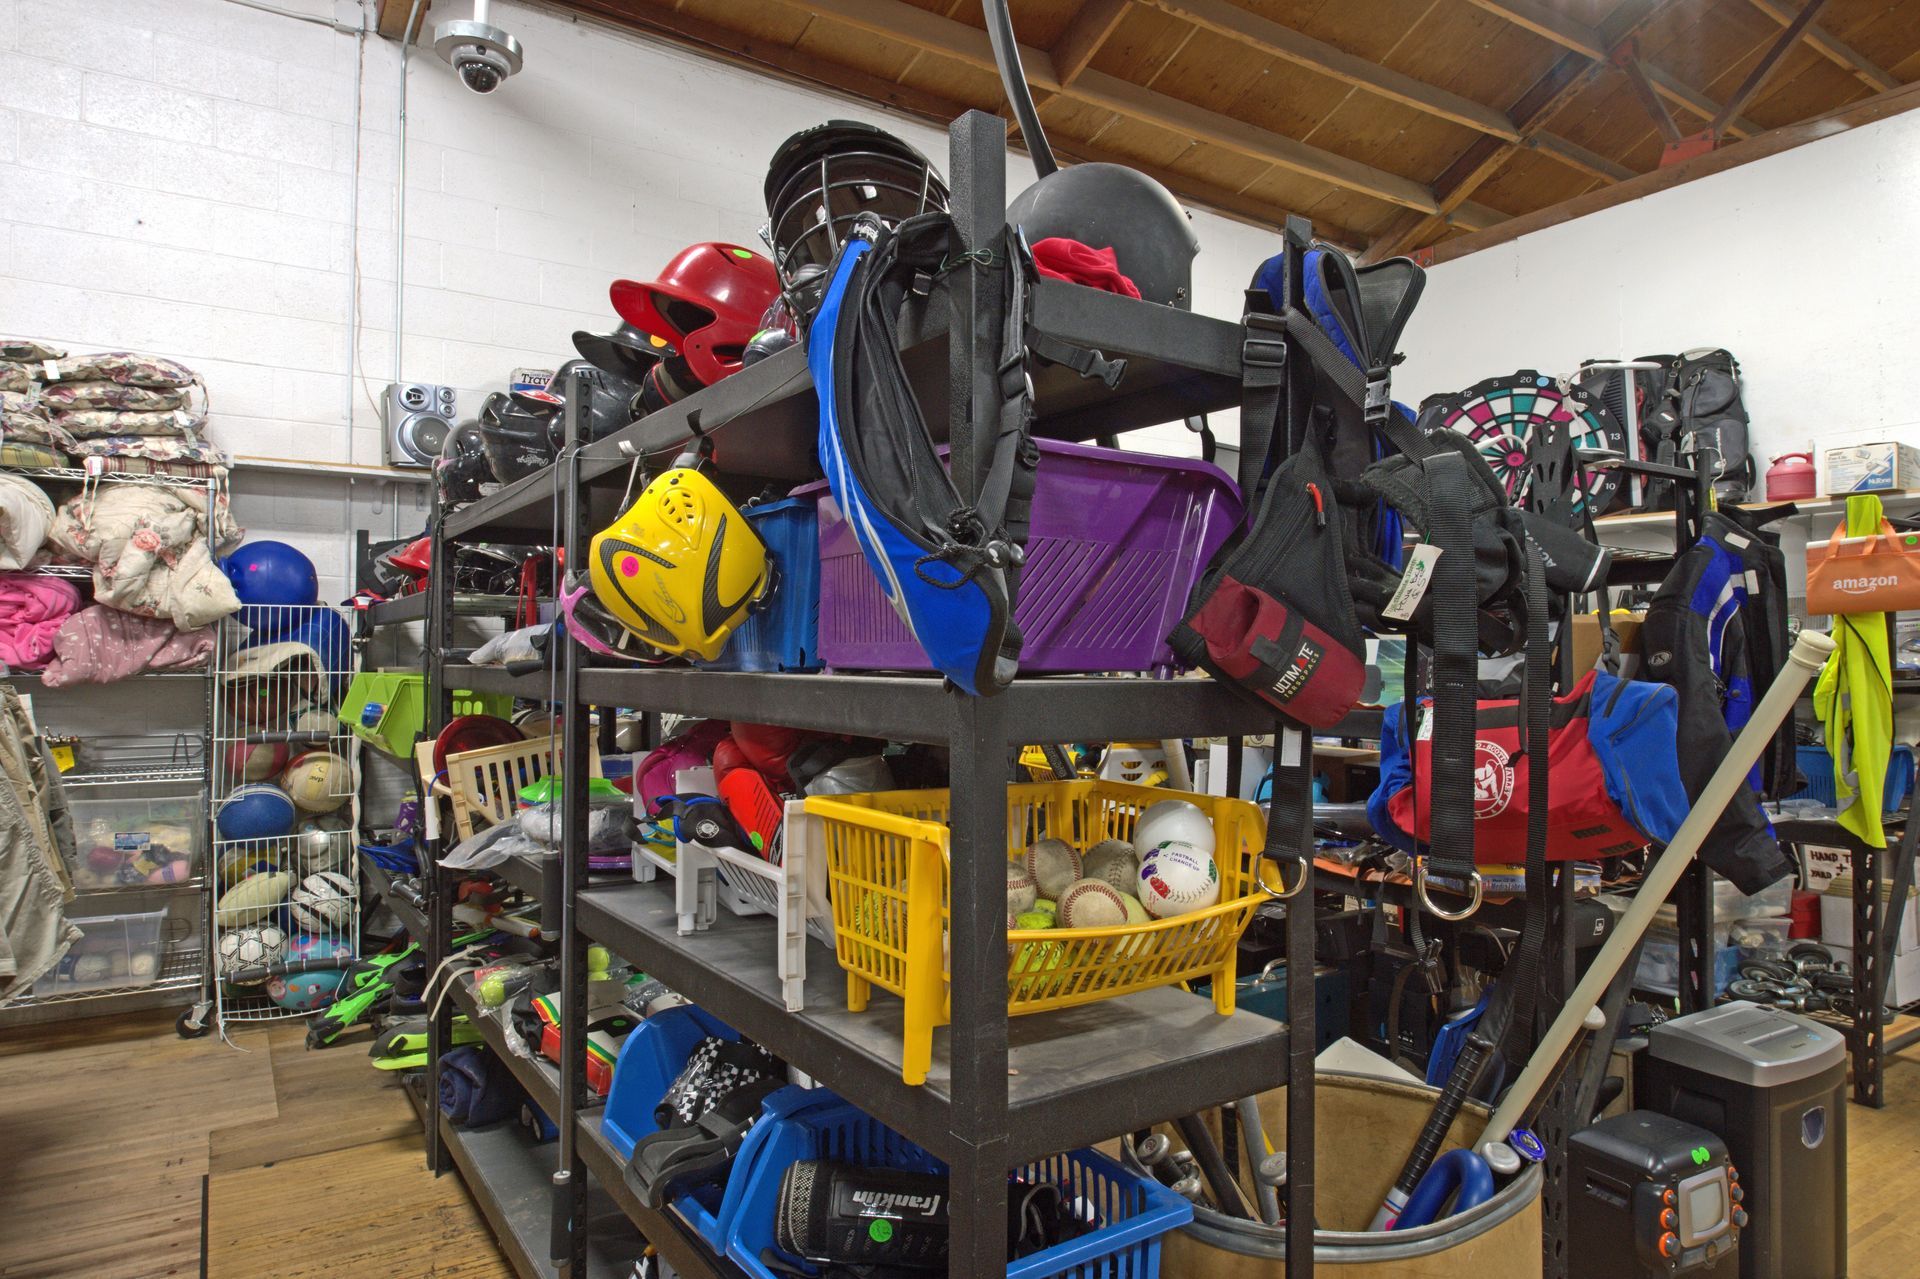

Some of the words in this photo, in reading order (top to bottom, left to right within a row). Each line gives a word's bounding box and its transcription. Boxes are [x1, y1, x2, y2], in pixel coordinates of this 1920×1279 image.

[1492, 380, 1499, 388] 5
[1519, 376, 1532, 384] 20
[1463, 390, 1473, 399] 12
[1577, 391, 1588, 400] 18
[1441, 406, 1448, 414] 9
[1423, 428, 1433, 436] 14
[1609, 432, 1621, 441] 13
[1605, 482, 1616, 490] 10
[1832, 575, 1899, 590] amazon
[1272, 641, 1314, 694] ULTIMATE
[1171, 852, 1199, 865] FASTBALL
[1810, 850, 1838, 862] HAND
[1169, 857, 1192, 868] CHANGE
[1810, 868, 1832, 880] YARD
